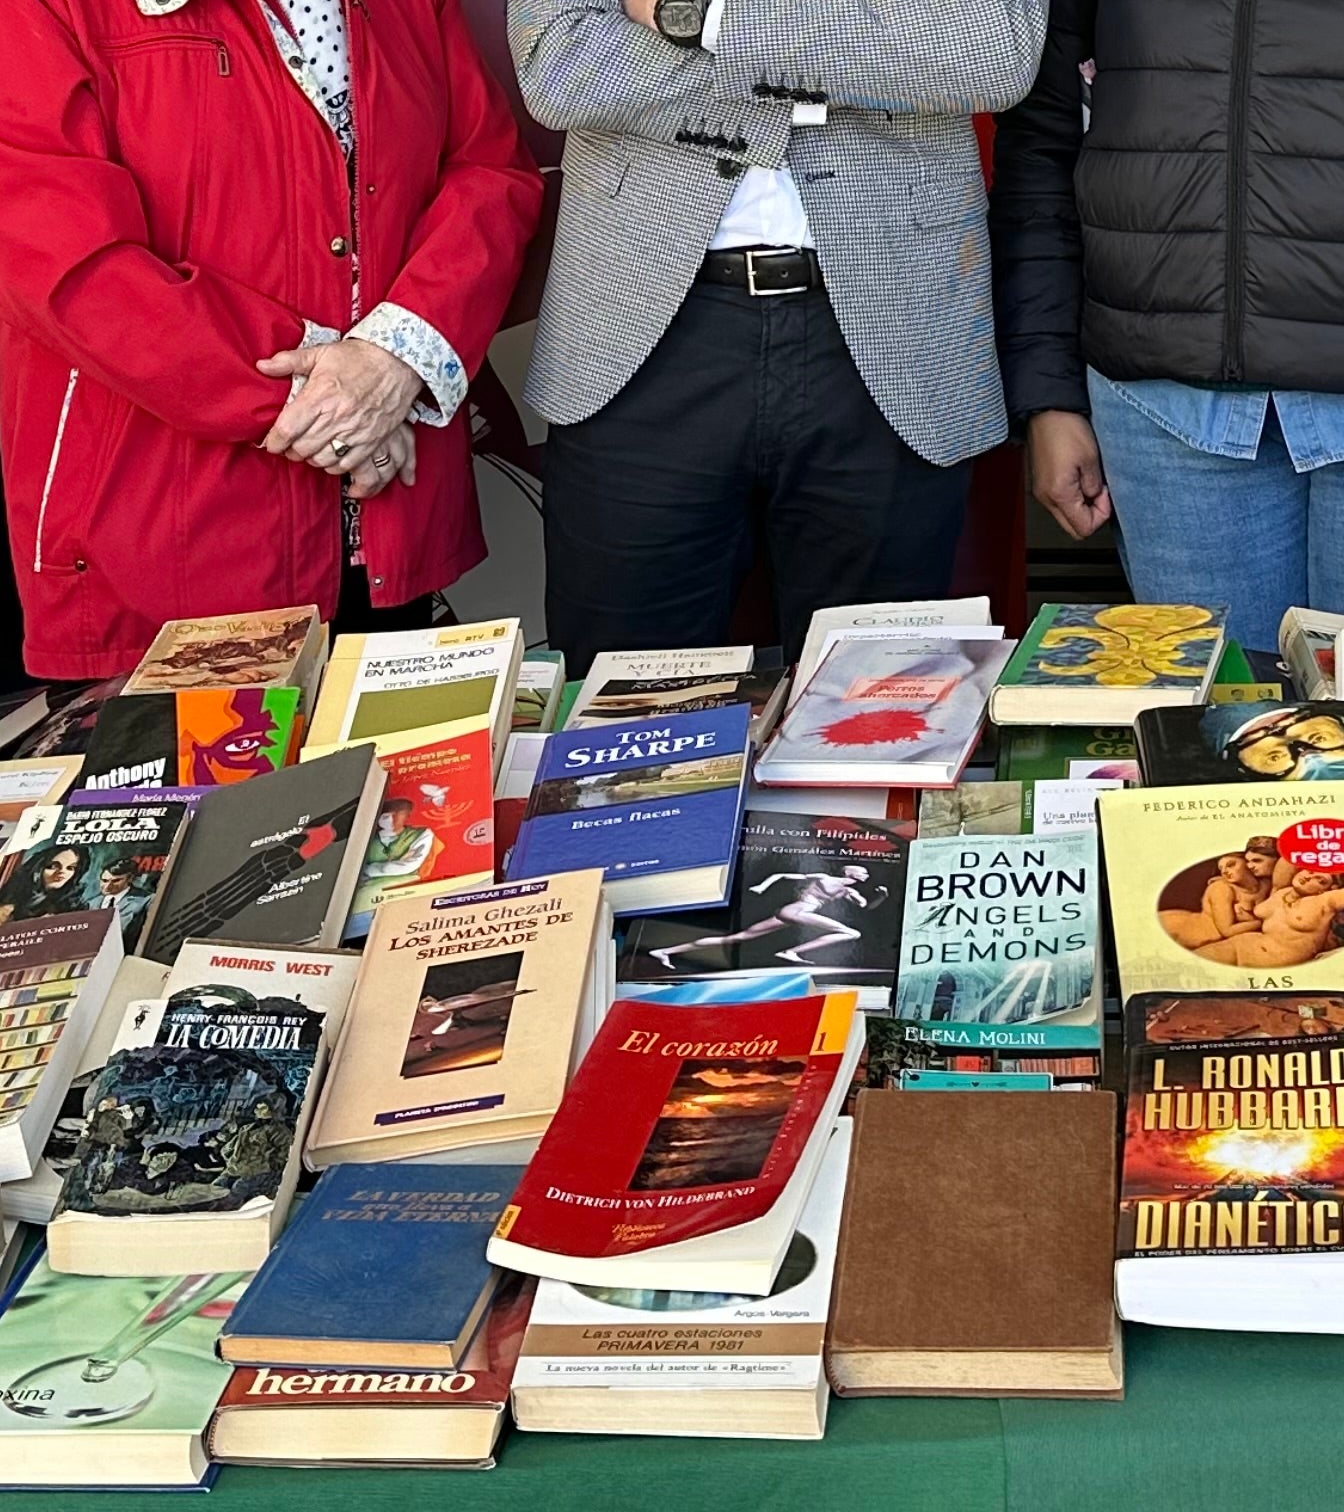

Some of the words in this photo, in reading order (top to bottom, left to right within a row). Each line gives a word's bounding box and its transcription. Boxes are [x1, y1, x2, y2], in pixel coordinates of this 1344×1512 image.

[615, 727, 671, 744] TOM
[563, 731, 717, 769] SHARPE
[1143, 798, 1231, 813] FEDERICO
[1238, 794, 1336, 809] ANDAHAZI
[61, 818, 161, 832] LOLA
[55, 832, 102, 845] ESPEJO
[107, 829, 158, 841] OSCURO
[1315, 839, 1341, 852] de
[959, 850, 1047, 869] DAN
[915, 867, 1087, 904] BROWN
[405, 911, 476, 935] Salima
[484, 897, 563, 922] Ghezali
[924, 900, 1083, 928] ANGELS
[388, 932, 433, 952] LOS
[438, 916, 539, 943] AMANTES
[544, 912, 573, 927] DE
[963, 925, 1035, 940] AND
[415, 931, 538, 960] SHEREZADE
[910, 932, 1087, 966] DEMONS
[208, 956, 276, 972] MORRIS
[285, 962, 334, 977] WEST
[1247, 975, 1294, 989] LAS
[164, 1023, 191, 1047] LA
[198, 1024, 302, 1050] COMEDIA
[618, 1029, 656, 1054] El
[661, 1033, 780, 1058] corazón
[903, 1026, 970, 1044] ELENA
[979, 1028, 1047, 1045] MOLINI
[1153, 1066, 1186, 1091] L.
[544, 1186, 621, 1209] DIETRICH
[624, 1194, 655, 1208] VON
[657, 1184, 756, 1208] HILDEBRAND
[581, 1327, 612, 1342] Las
[616, 1328, 667, 1341] cuatro
[672, 1326, 764, 1341] estaciones
[596, 1338, 700, 1352] PRIMAVERA
[707, 1339, 746, 1352] 1981
[245, 1367, 476, 1396] hermano
